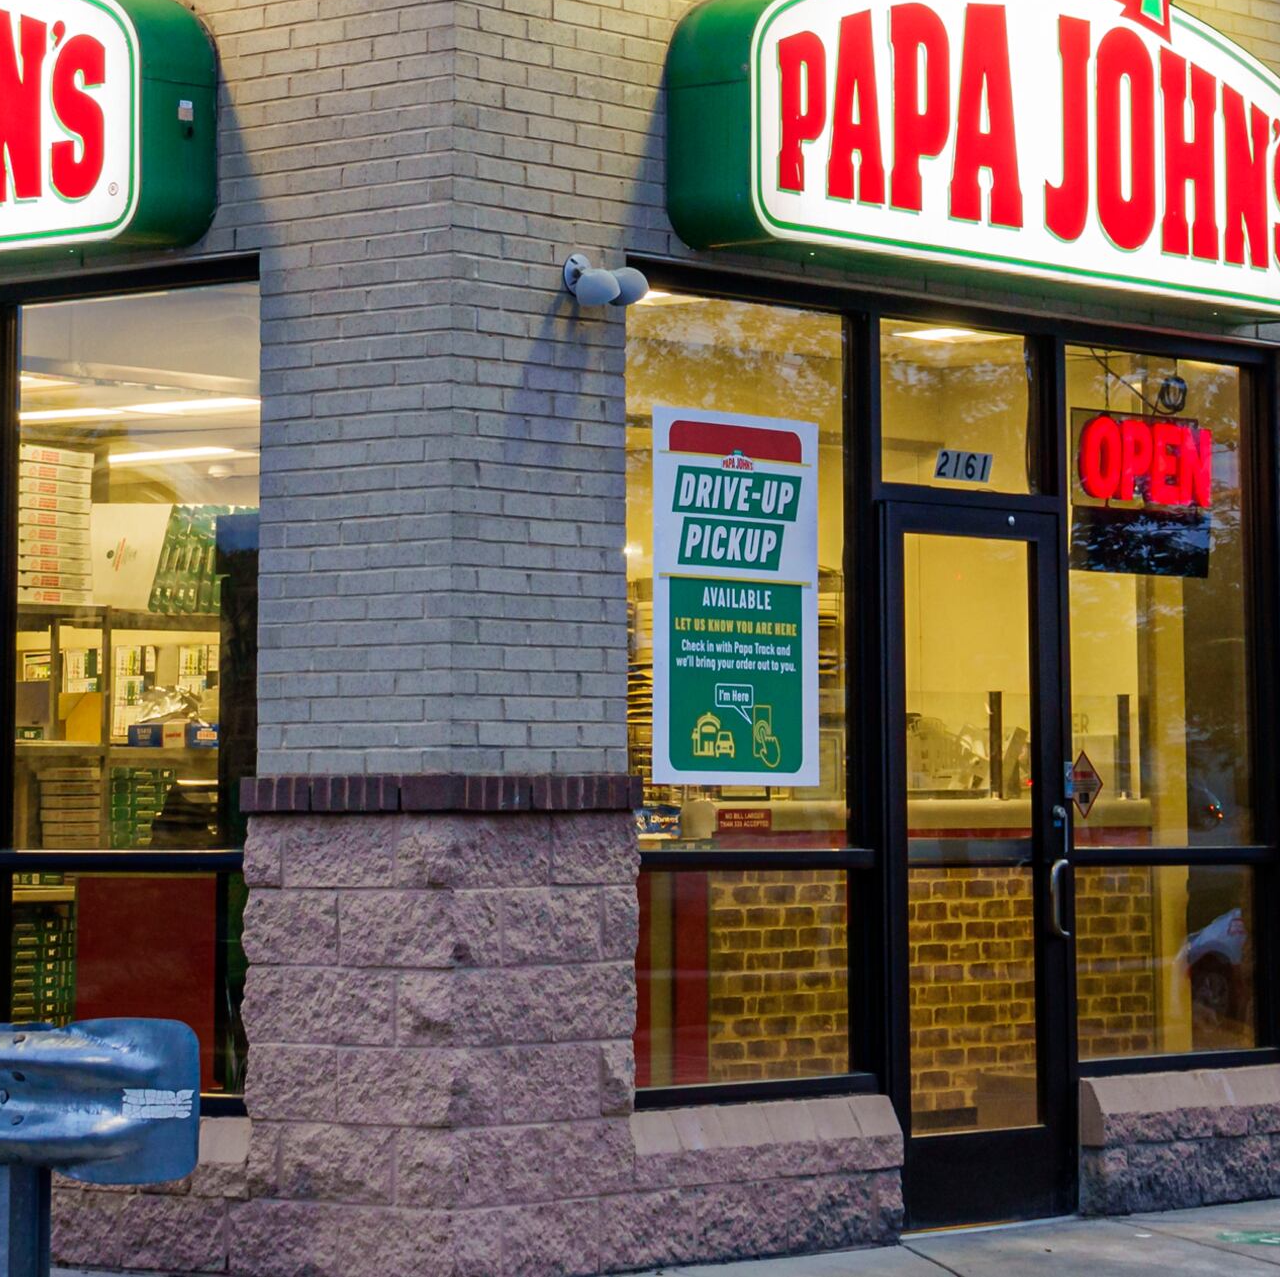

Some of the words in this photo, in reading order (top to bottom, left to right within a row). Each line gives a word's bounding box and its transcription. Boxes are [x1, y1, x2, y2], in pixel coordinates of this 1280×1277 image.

[777, 3, 1023, 228] PAPA
[937, 450, 989, 481] 2161
[1080, 415, 1212, 508] OPEN
[678, 472, 794, 515] DRIVE-UP
[684, 523, 777, 563] PICKUP
[702, 586, 772, 611] AVAILABLE
[675, 617, 691, 630] LET
[694, 618, 705, 631] US
[708, 619, 734, 633] KNOW
[736, 621, 752, 634] YOU
[756, 622, 772, 635] ARE
[775, 623, 797, 637] HERE
[681, 638, 705, 652] Check
[707, 641, 714, 652] in
[715, 641, 733, 653] with
[734, 642, 753, 657] Papa
[755, 643, 774, 655] Track
[776, 644, 791, 656] and
[676, 656, 694, 667] we'll
[695, 657, 715, 672] bring
[717, 660, 734, 672] your
[735, 658, 756, 670] order
[757, 660, 770, 671] out
[771, 660, 779, 670] to
[780, 662, 796, 674] you.
[719, 689, 730, 701] I'm
[732, 690, 749, 702] Here
